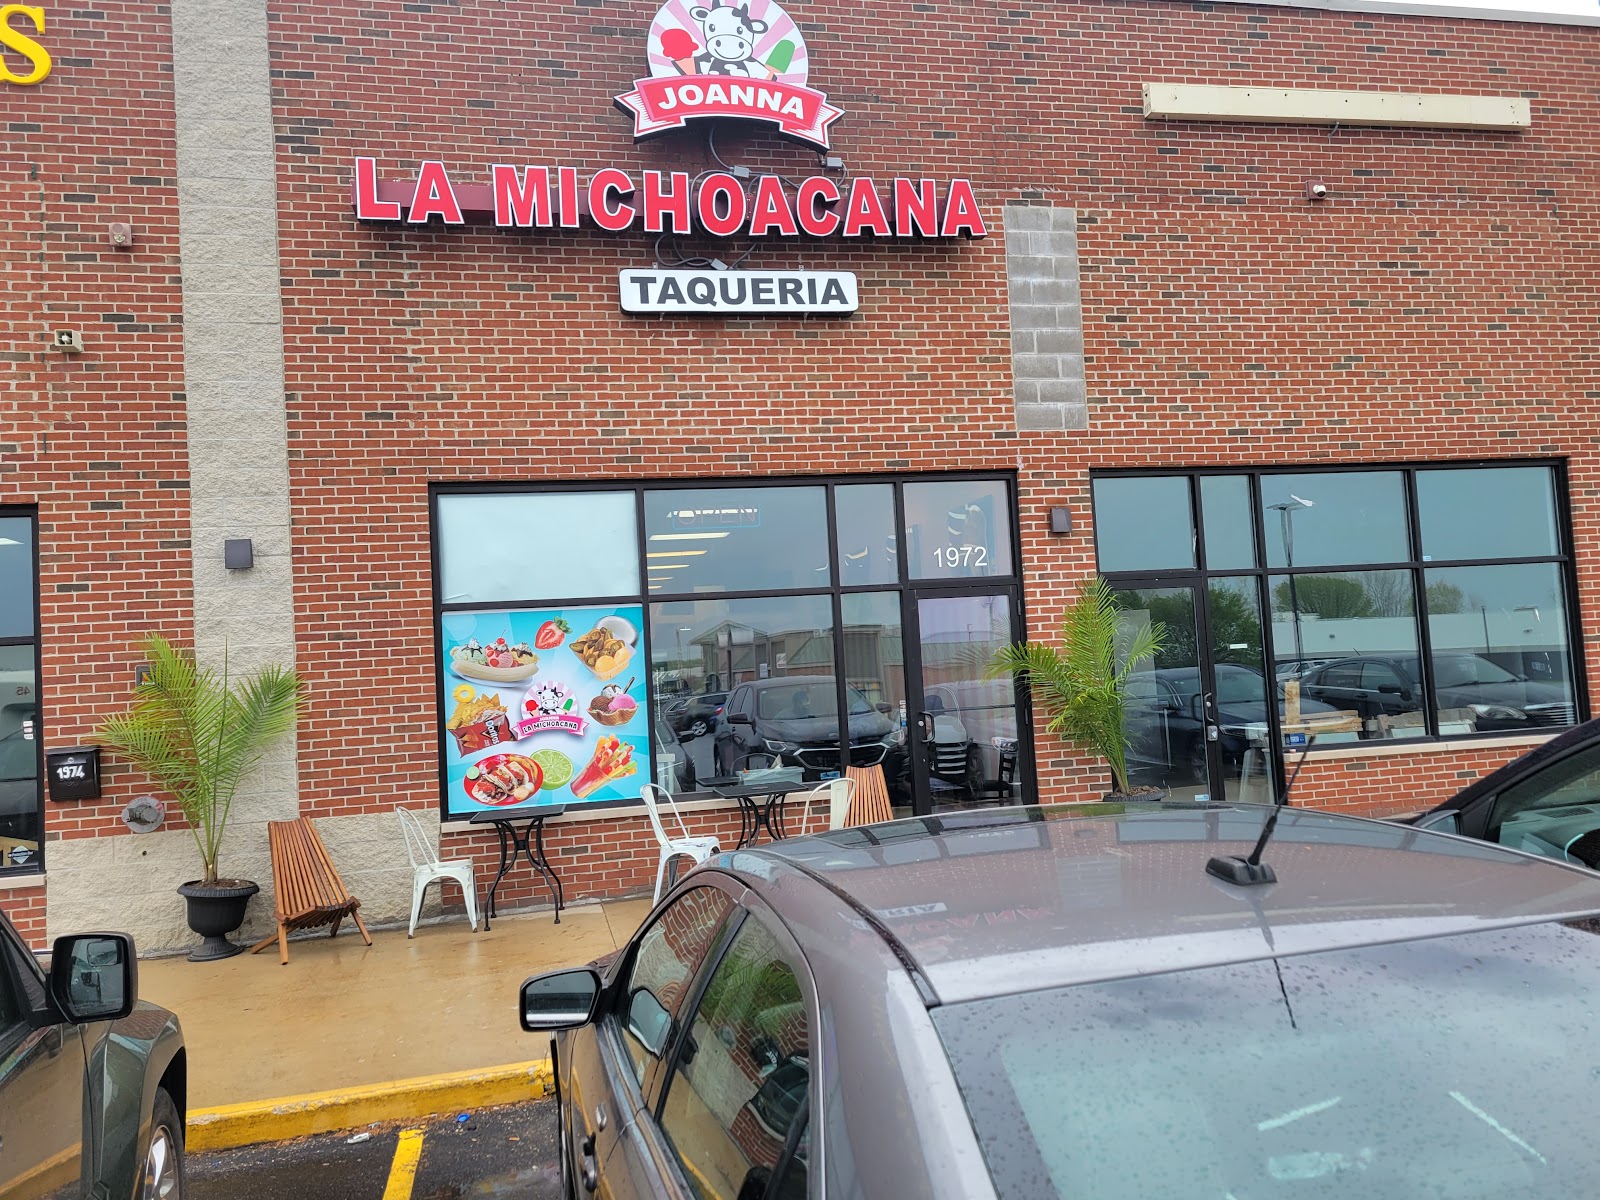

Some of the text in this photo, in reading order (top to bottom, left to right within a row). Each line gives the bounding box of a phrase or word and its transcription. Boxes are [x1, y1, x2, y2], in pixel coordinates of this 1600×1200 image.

[658, 84, 804, 119] JOANNA
[355, 156, 988, 236] LA MICHOACANA
[630, 276, 849, 306] TAQUERIA
[933, 546, 988, 568] 1972
[533, 721, 578, 730] MICHOACANA
[56, 765, 86, 779] 1974
